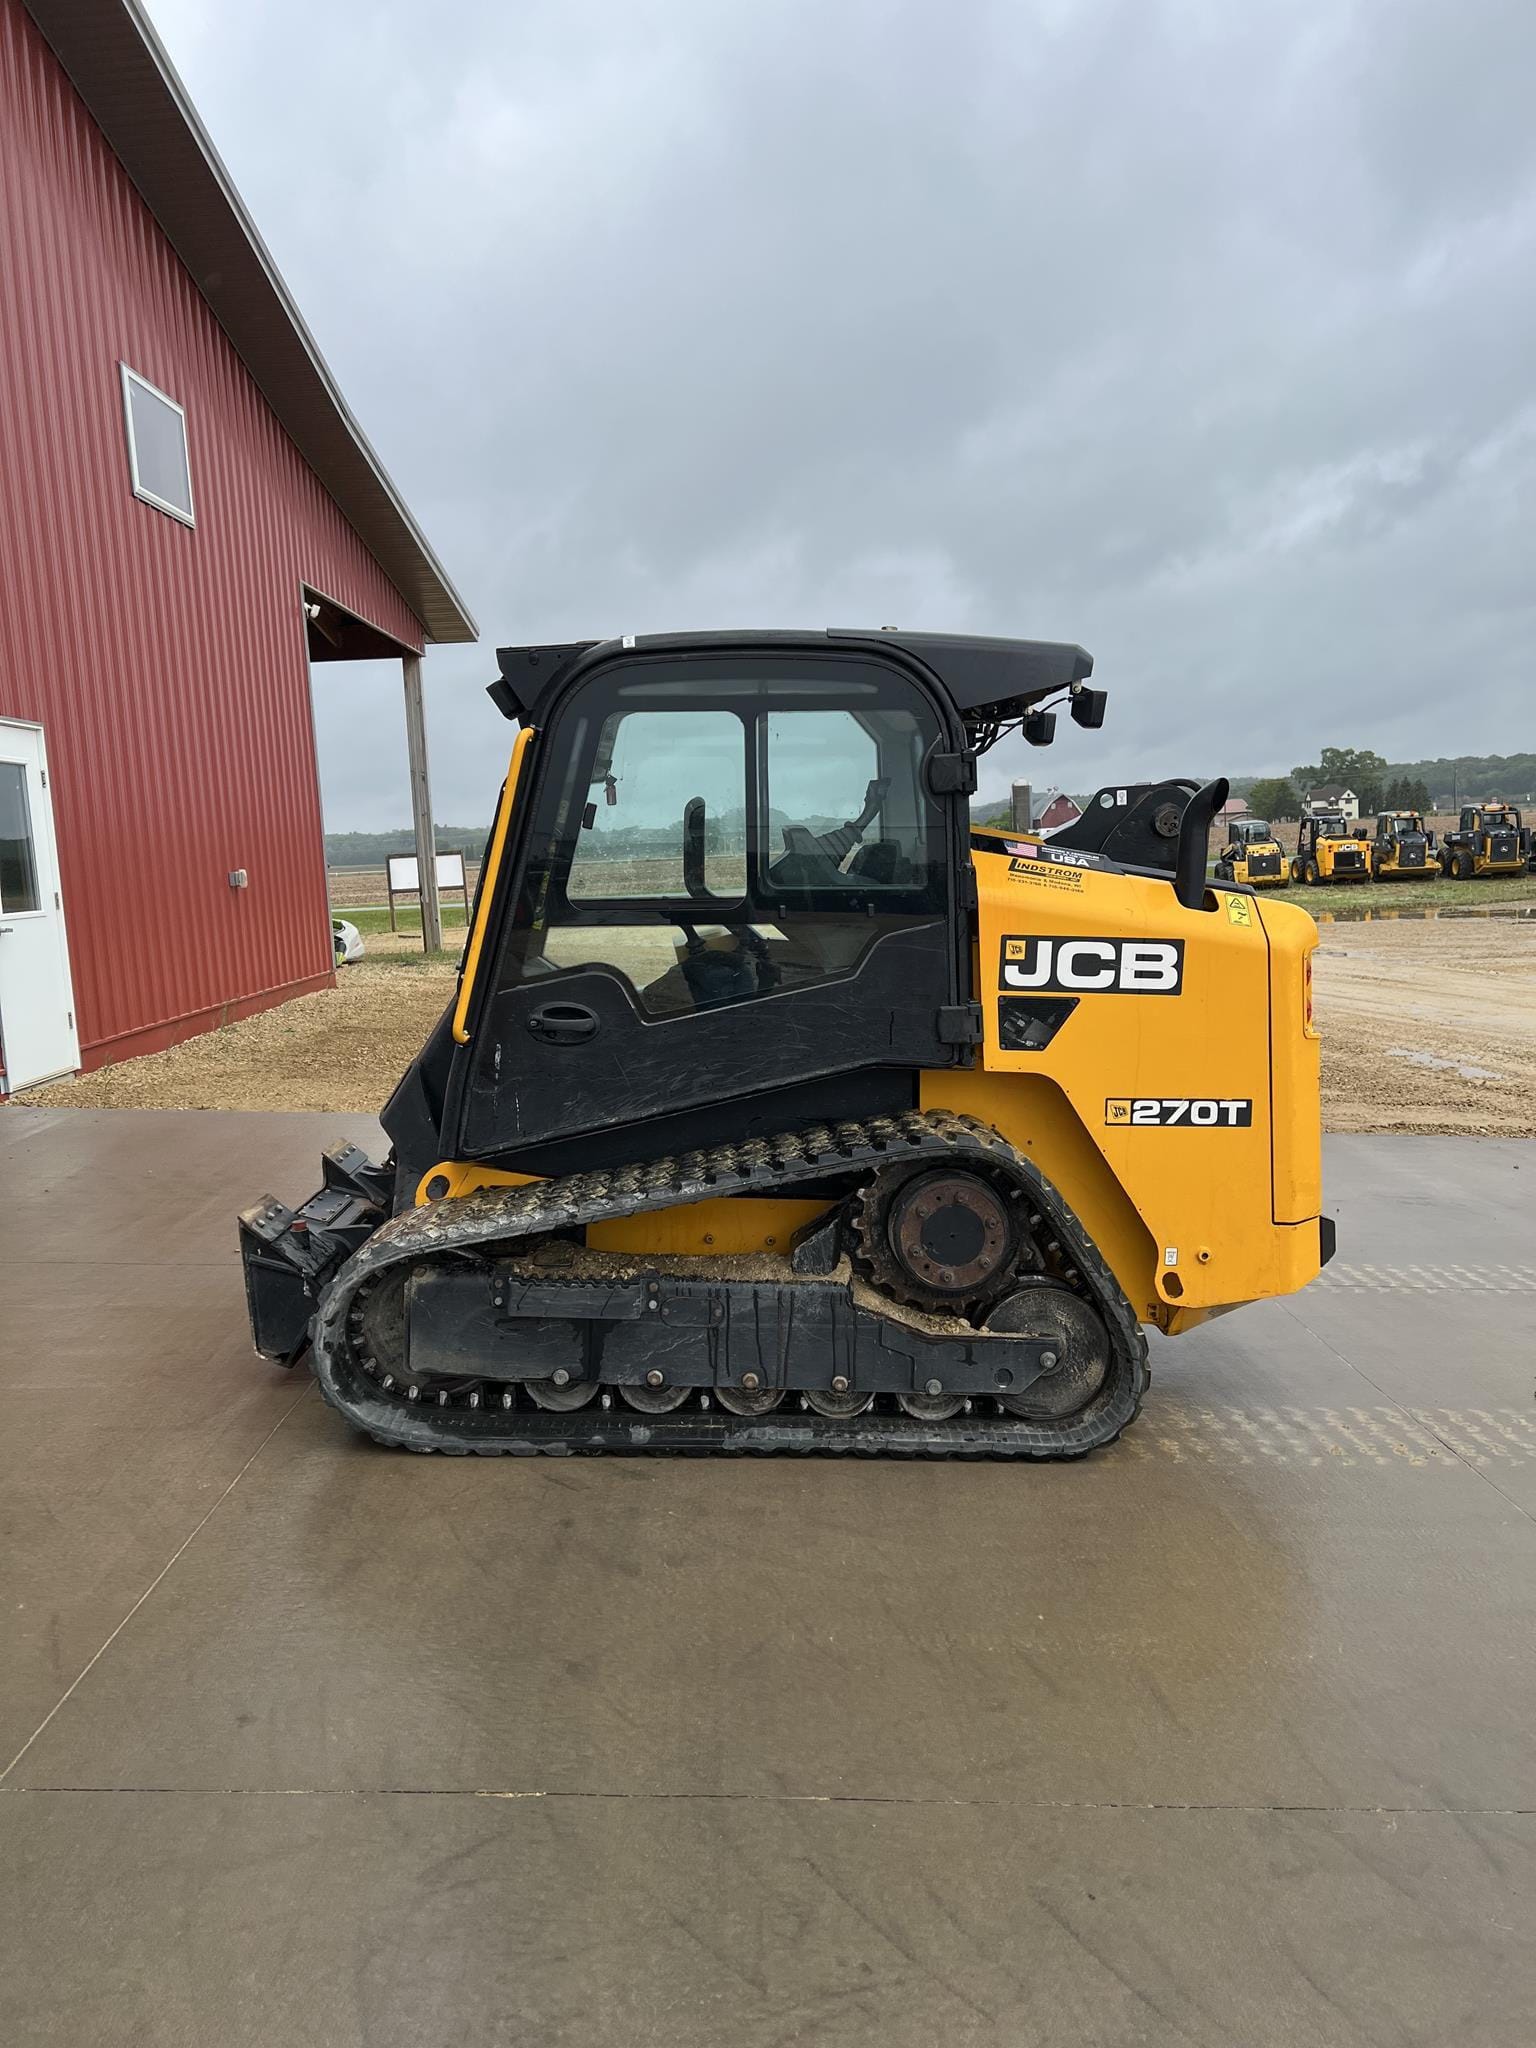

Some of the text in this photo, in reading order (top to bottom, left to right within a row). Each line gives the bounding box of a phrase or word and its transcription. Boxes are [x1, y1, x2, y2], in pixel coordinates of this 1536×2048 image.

[1008, 857, 1083, 879] LINDSTROM
[1051, 853, 1090, 867] USA
[1004, 940, 1179, 990] JCB
[1112, 1100, 1247, 1125] JCB 270T
